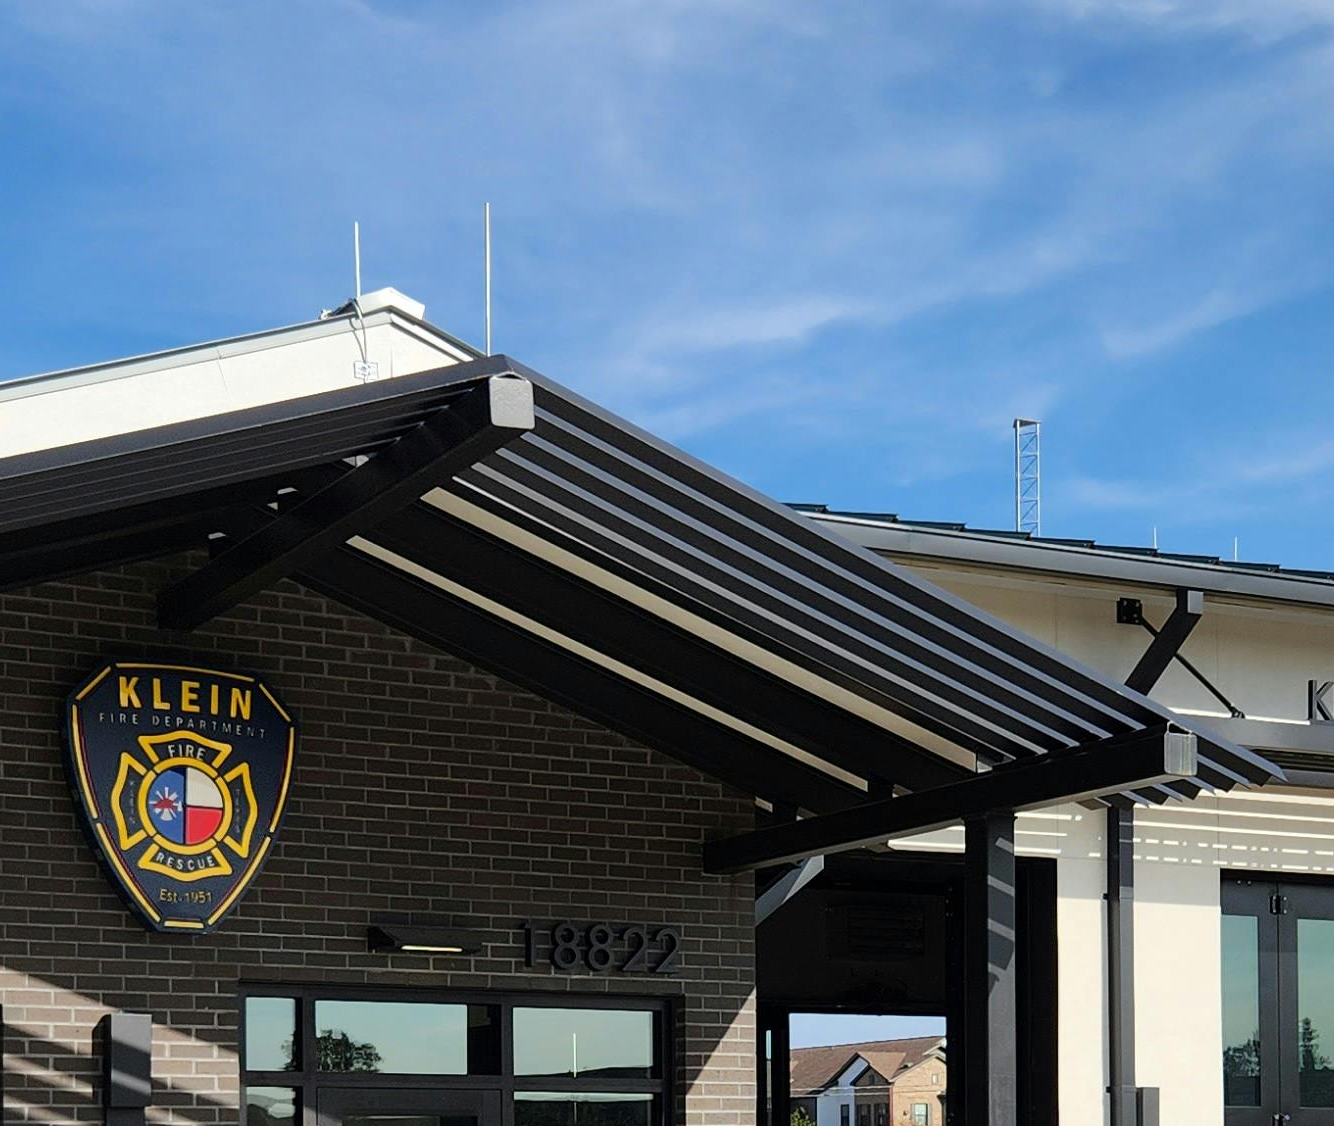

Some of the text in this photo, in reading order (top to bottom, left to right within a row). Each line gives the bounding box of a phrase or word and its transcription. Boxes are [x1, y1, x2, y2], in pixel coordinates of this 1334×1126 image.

[119, 675, 252, 721] KLEIN
[99, 712, 267, 740] FIRE DEPARTMENT
[167, 744, 207, 761] FIRE
[156, 851, 216, 871] RESCUE
[520, 921, 682, 974] 18822
